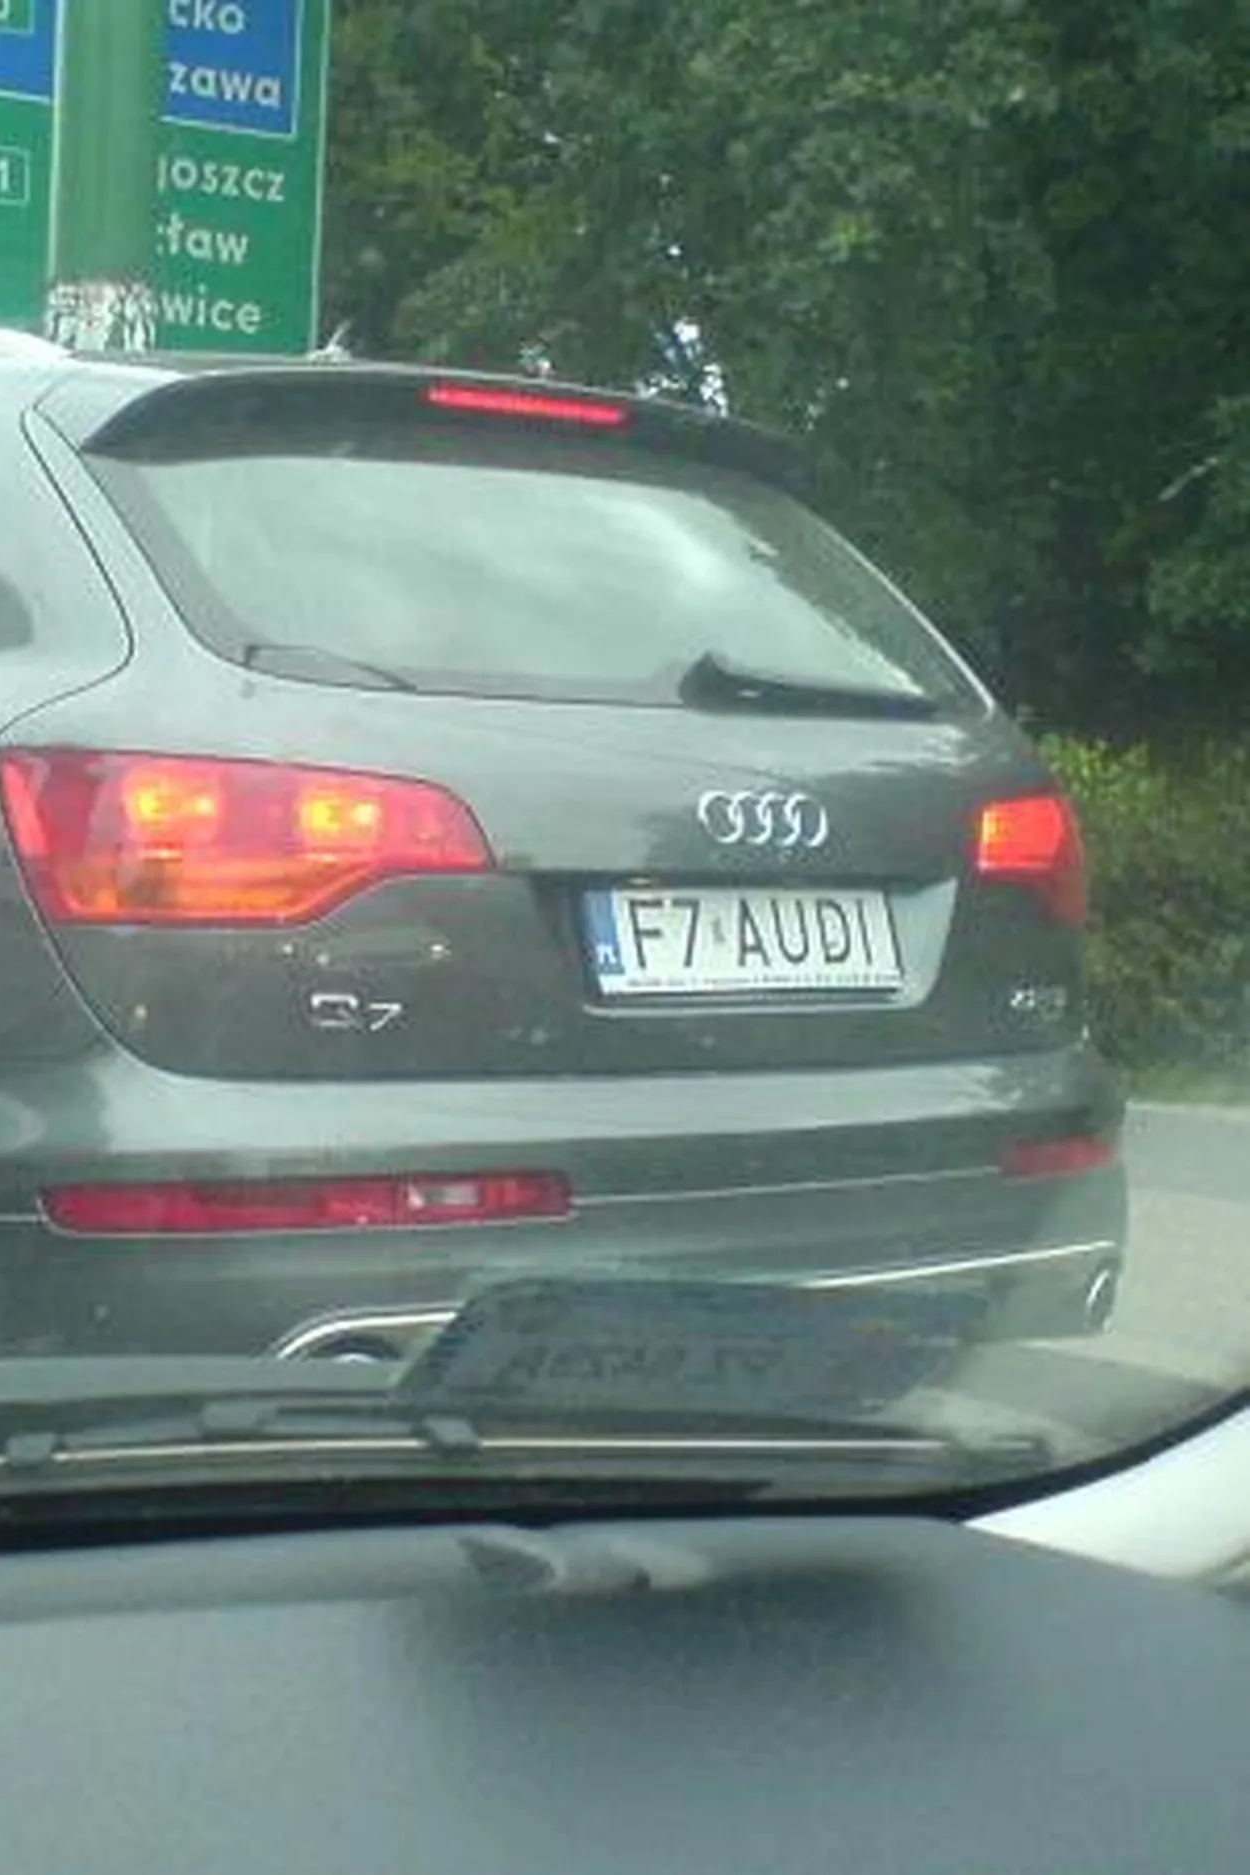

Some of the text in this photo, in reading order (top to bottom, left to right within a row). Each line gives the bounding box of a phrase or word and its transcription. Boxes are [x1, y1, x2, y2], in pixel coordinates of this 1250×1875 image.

[168, 61, 282, 110] zawa
[157, 154, 285, 201] oszcz
[156, 211, 249, 265] ław
[626, 896, 872, 969] F7 AUDI
